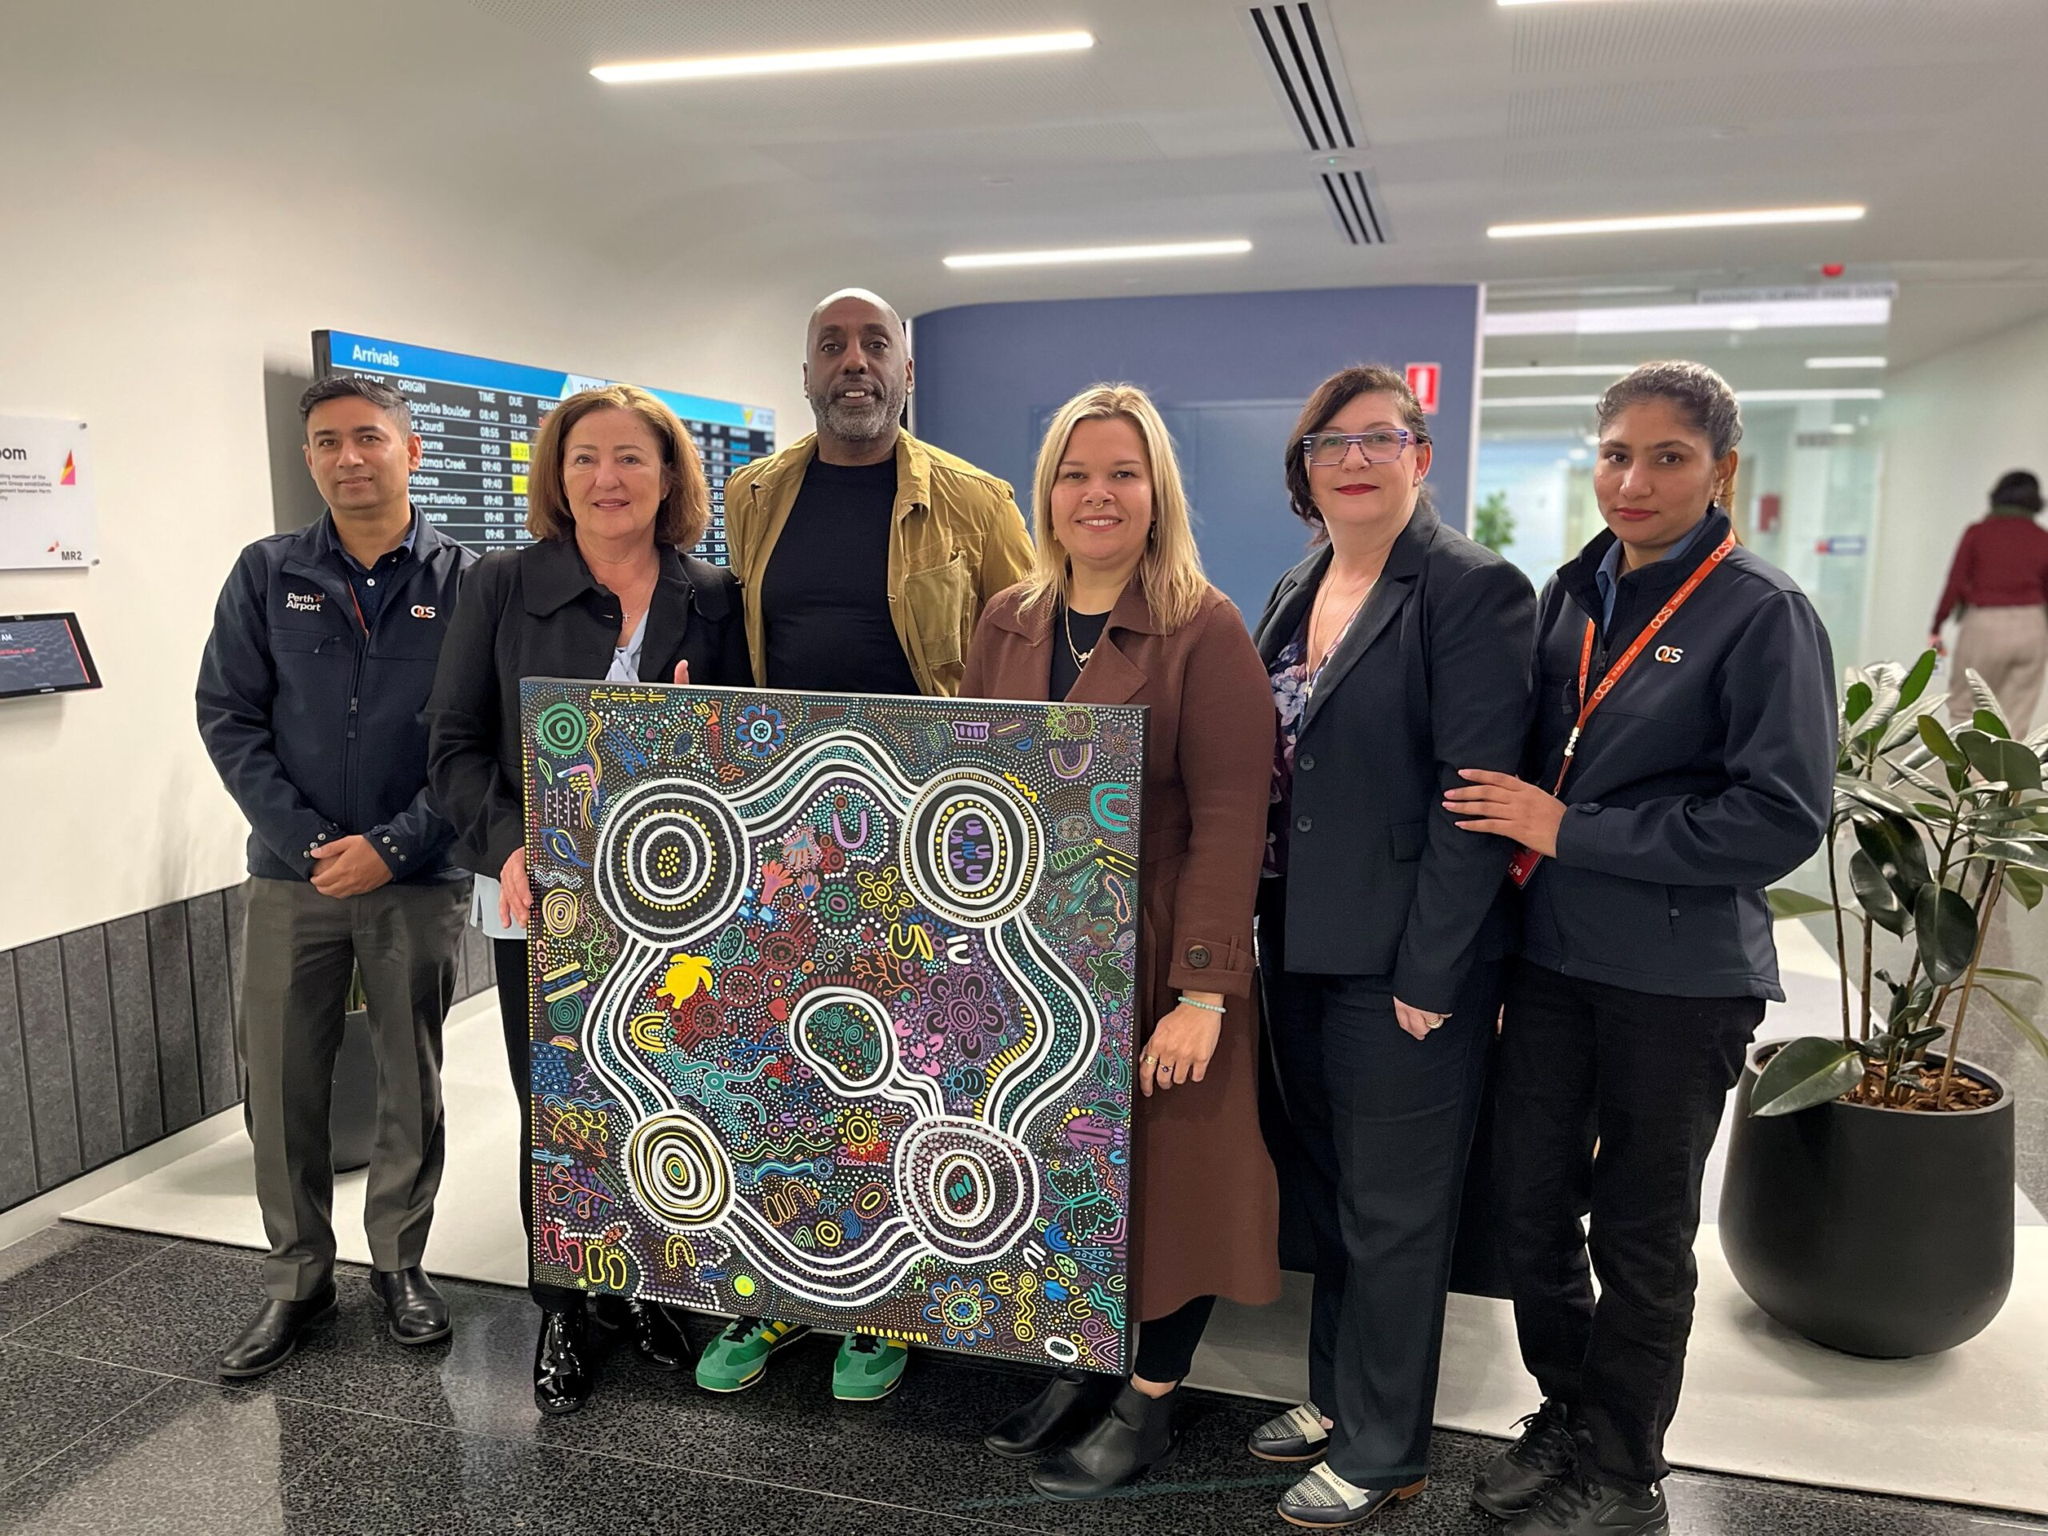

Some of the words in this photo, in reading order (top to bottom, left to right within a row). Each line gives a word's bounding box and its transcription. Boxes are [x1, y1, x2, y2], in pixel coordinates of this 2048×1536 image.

[352, 344, 400, 368] Arrivals
[397, 379, 427, 394] ORIGIN
[478, 391, 496, 404] TIME
[508, 395, 524, 407] DUE
[441, 404, 472, 418] Boulder
[509, 412, 528, 425] 11:20
[510, 430, 529, 441] 11:45
[444, 457, 468, 470] Creek
[481, 460, 502, 473] 09:40
[482, 477, 503, 490] 09:40
[483, 494, 504, 506] 09:40
[513, 495, 528, 507] 10:2
[484, 511, 505, 523] 09:40
[485, 528, 506, 540] 09:45
[61, 551, 83, 561] MR2
[287, 592, 314, 603] Perth
[285, 600, 321, 611] Airport
[1650, 606, 1674, 629] OCS
[1593, 677, 1615, 700] OCS
